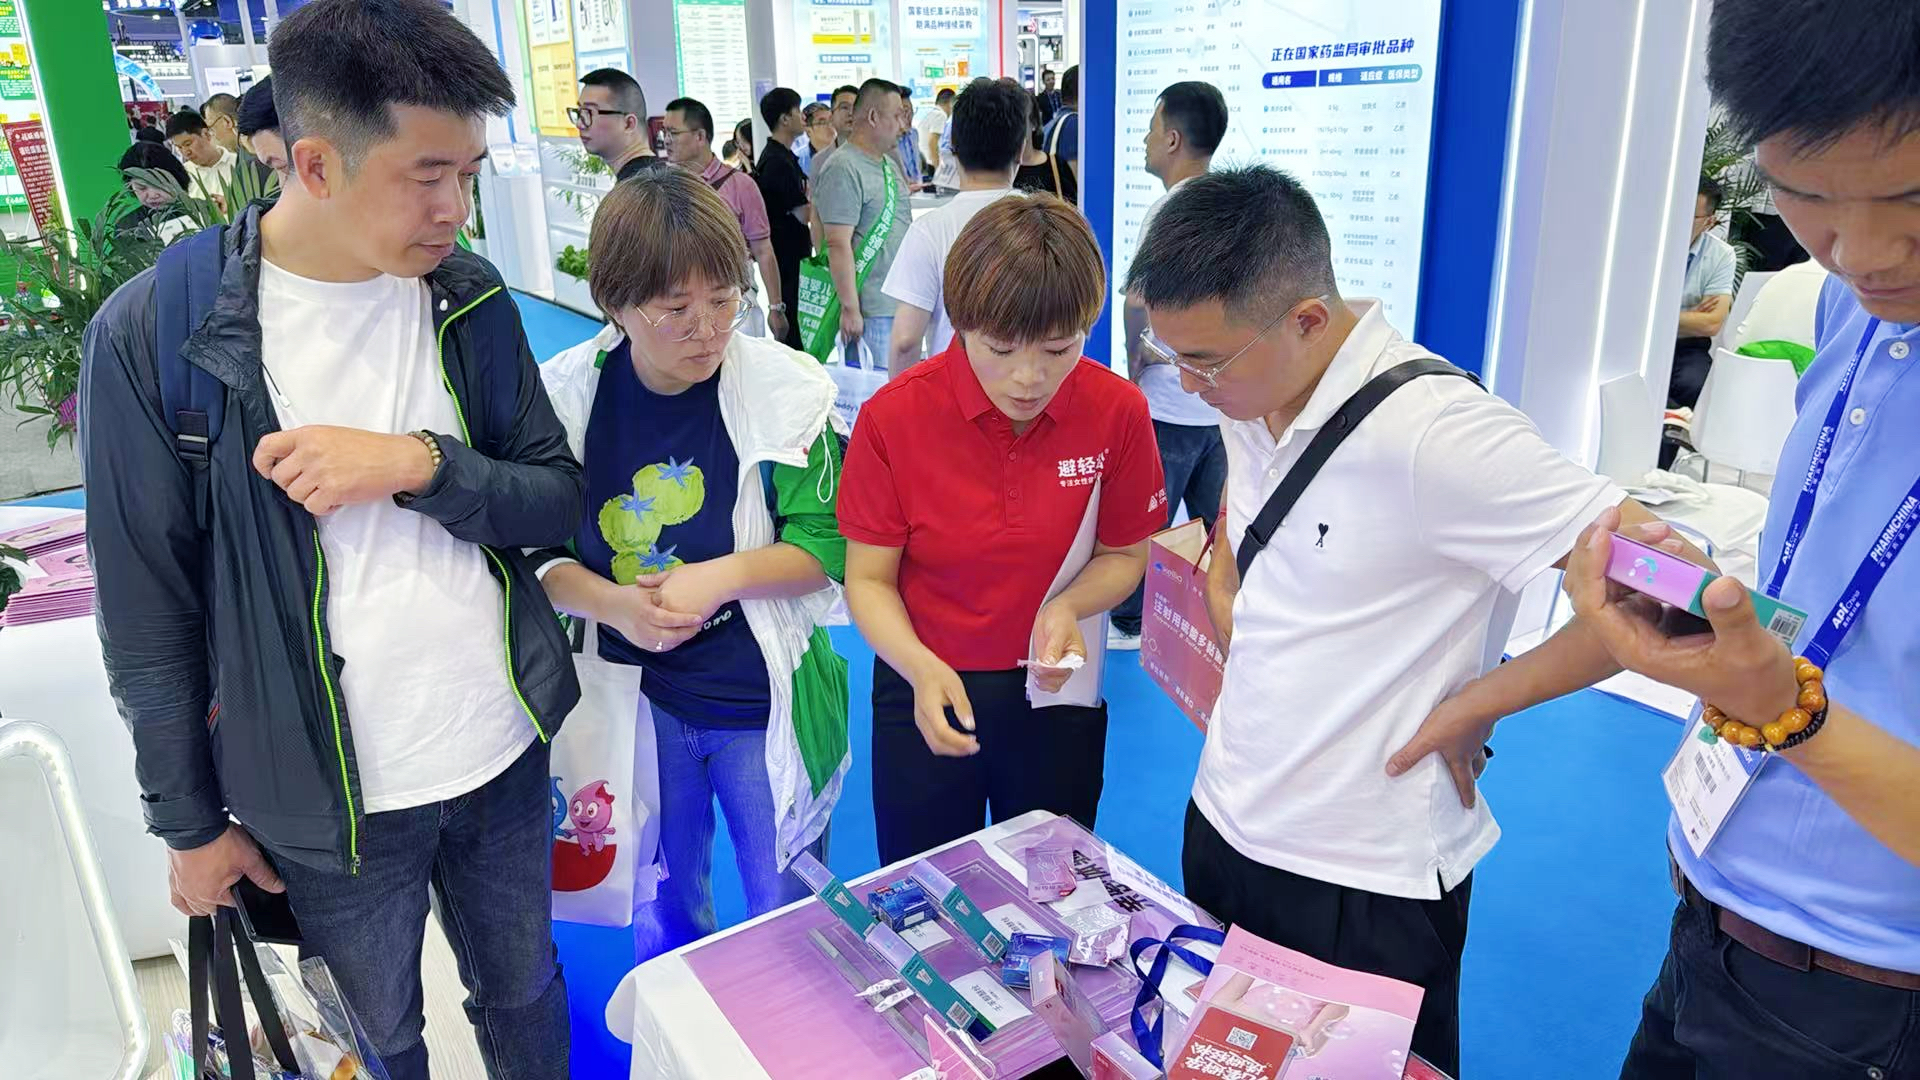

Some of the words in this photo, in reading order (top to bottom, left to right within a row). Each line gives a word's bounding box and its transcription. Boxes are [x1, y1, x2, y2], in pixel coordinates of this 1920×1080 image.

[1271, 37, 1415, 62] 正在国家药监局审批品种
[1360, 70, 1383, 81] 适应症
[1387, 68, 1418, 80] 医保类型
[1802, 425, 1832, 493] PHARMCHINA
[1870, 495, 1919, 562] PHARMCHINA
